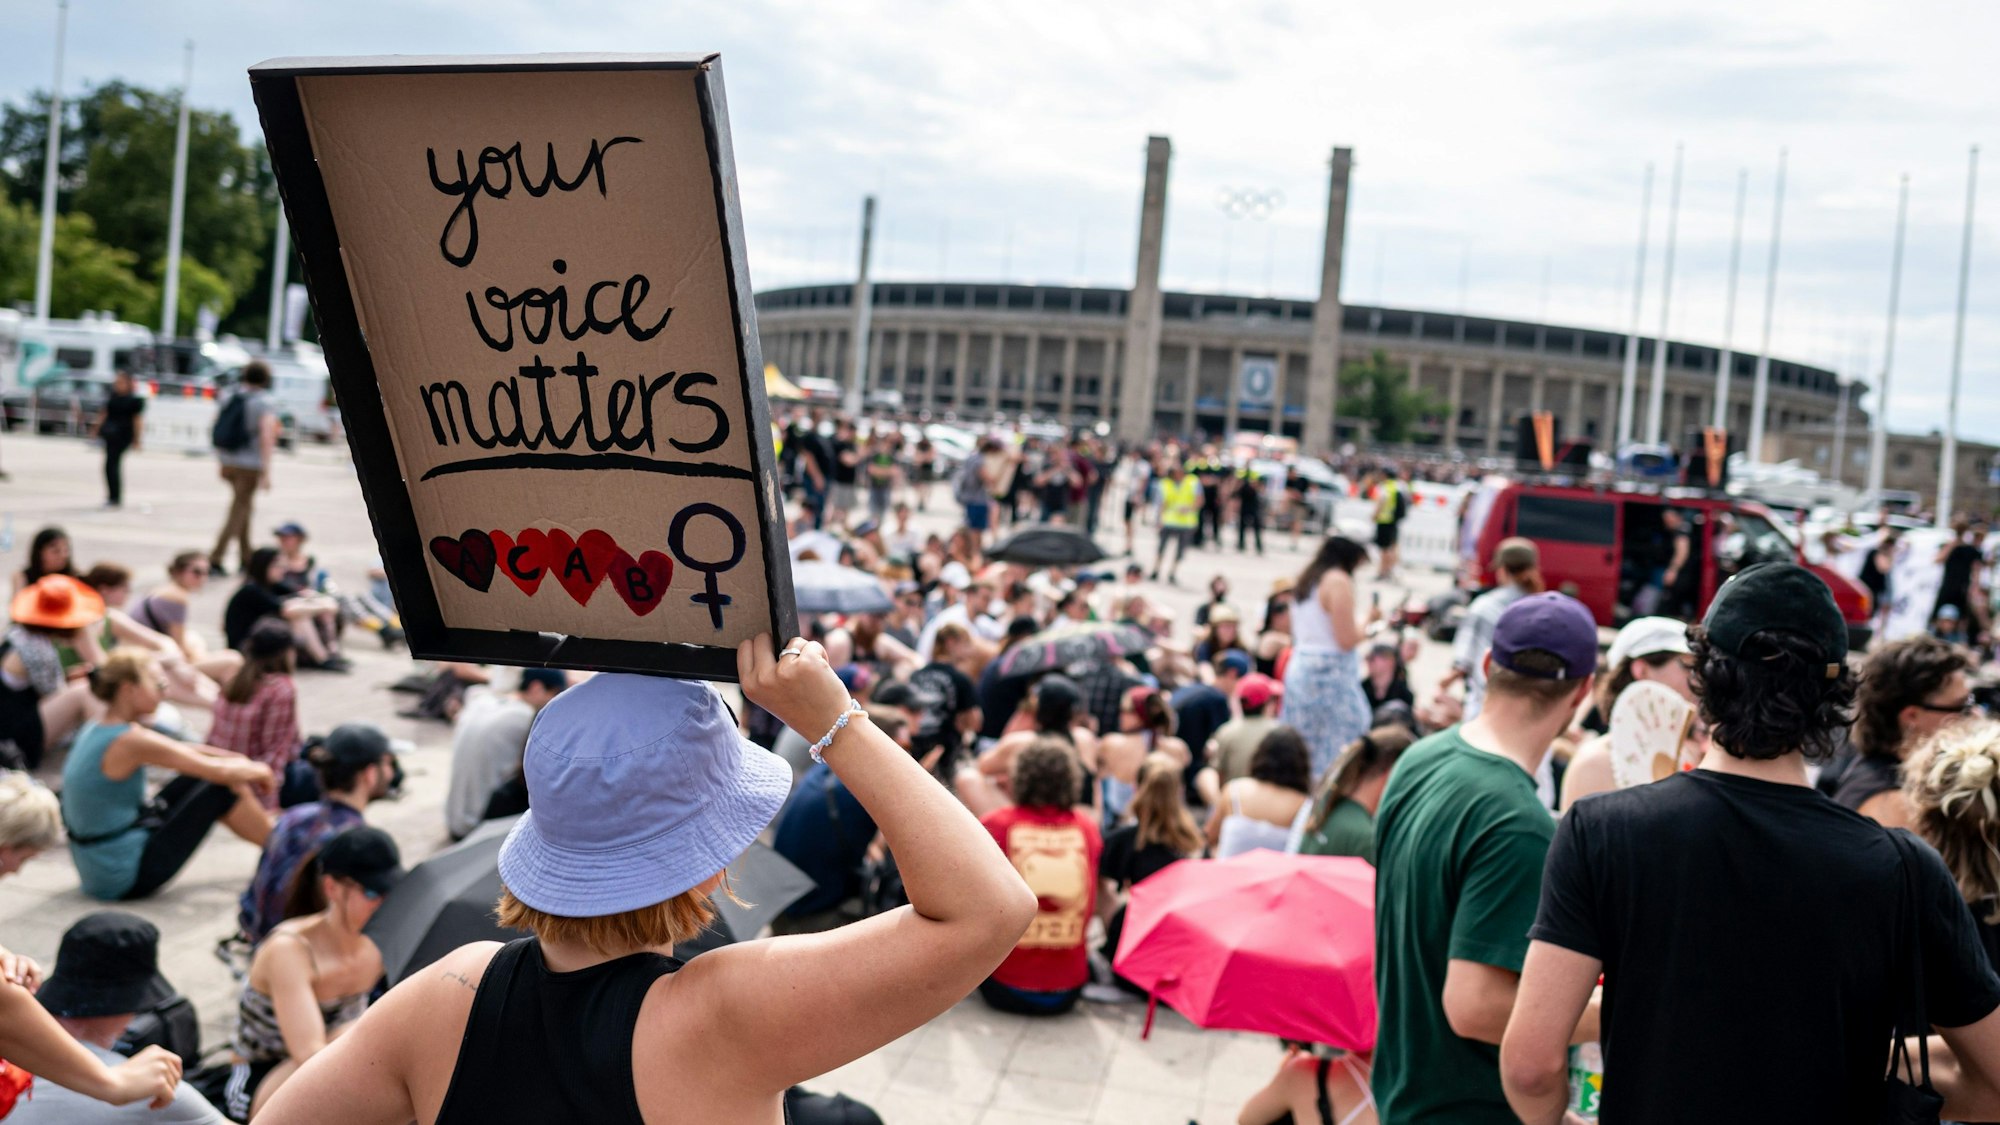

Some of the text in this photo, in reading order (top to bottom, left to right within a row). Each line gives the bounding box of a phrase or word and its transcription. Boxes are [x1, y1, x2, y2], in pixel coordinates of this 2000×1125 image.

[427, 137, 645, 268] your
[466, 258, 675, 353] voice
[419, 350, 731, 455] matters
